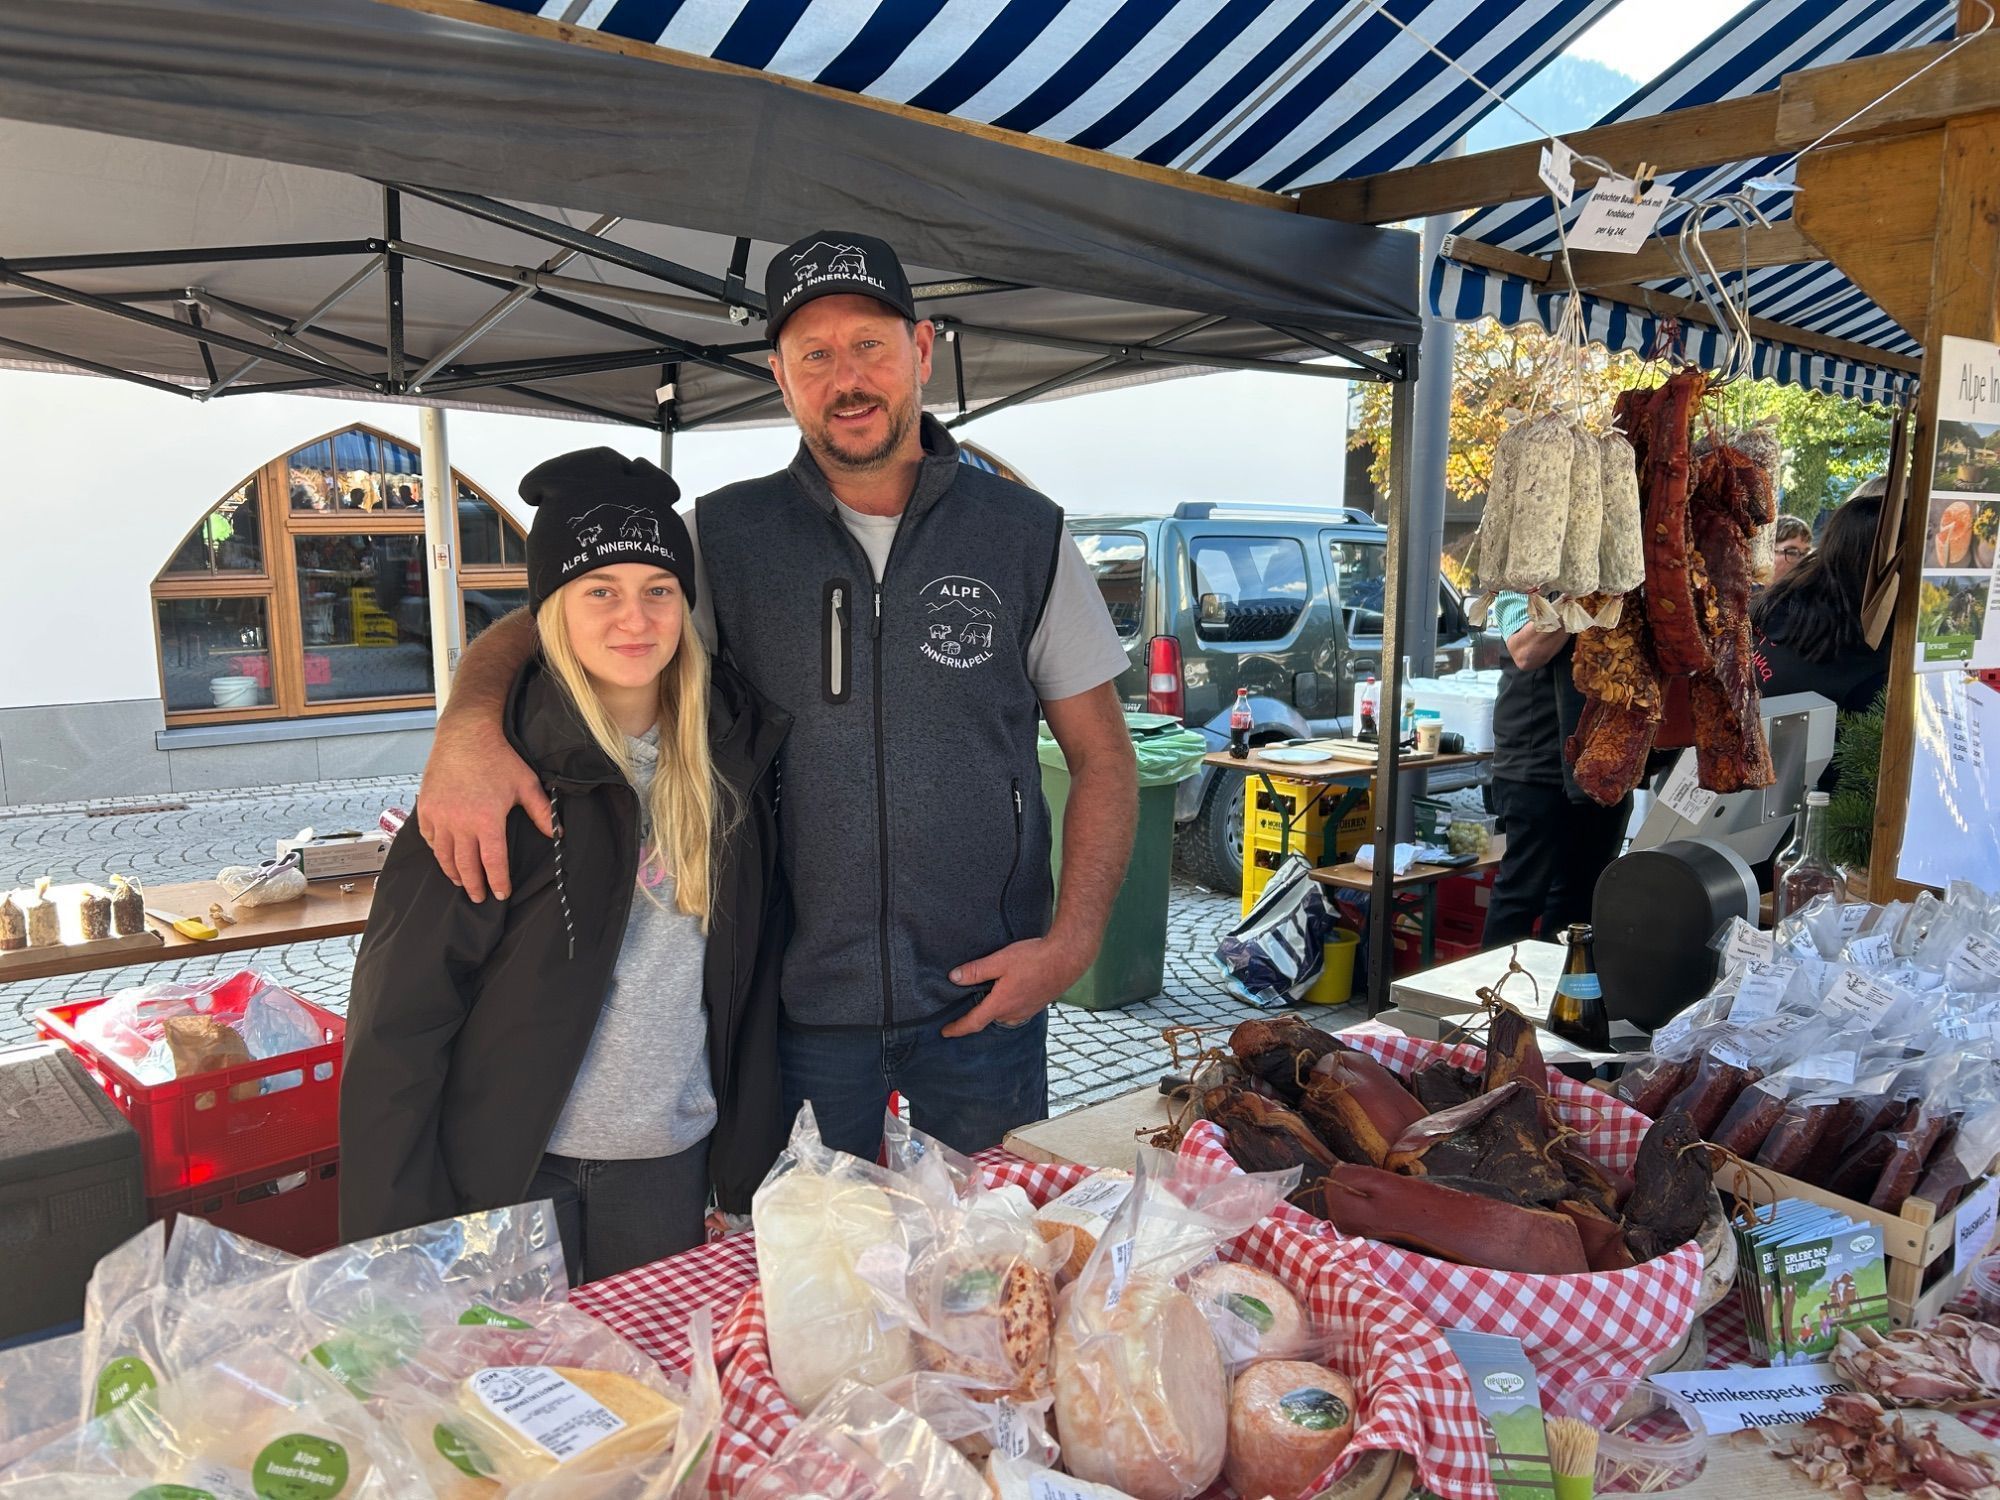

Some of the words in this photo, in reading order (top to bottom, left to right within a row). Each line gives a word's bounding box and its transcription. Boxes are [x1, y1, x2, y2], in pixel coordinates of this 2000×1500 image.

[1606, 209, 1635, 219] Knoblauch
[1595, 226, 1607, 236] per
[1607, 225, 1615, 236] kg
[782, 284, 803, 307] ALPE
[807, 272, 886, 290] INNERKAPELL
[1959, 362, 1986, 415] Alpe
[1990, 365, 2000, 403] In
[561, 551, 590, 574] ALPE
[596, 540, 676, 562] INNERKAPELL
[940, 584, 981, 598] ALPE
[920, 641, 994, 669] INNERKAPELL
[1339, 816, 1367, 829] OHREN
[1762, 1252, 1779, 1264] ERL
[1784, 1250, 1814, 1264] ERLEBE
[1813, 1247, 1828, 1259] DAS
[1763, 1262, 1779, 1274] HEU
[1681, 1384, 1809, 1404] Schinkenspeck
[1809, 1383, 1849, 1396] vom
[1739, 1407, 1823, 1429] Alpschwe
[293, 1451, 321, 1467] Alpe
[266, 1462, 335, 1487] Innerkapell
